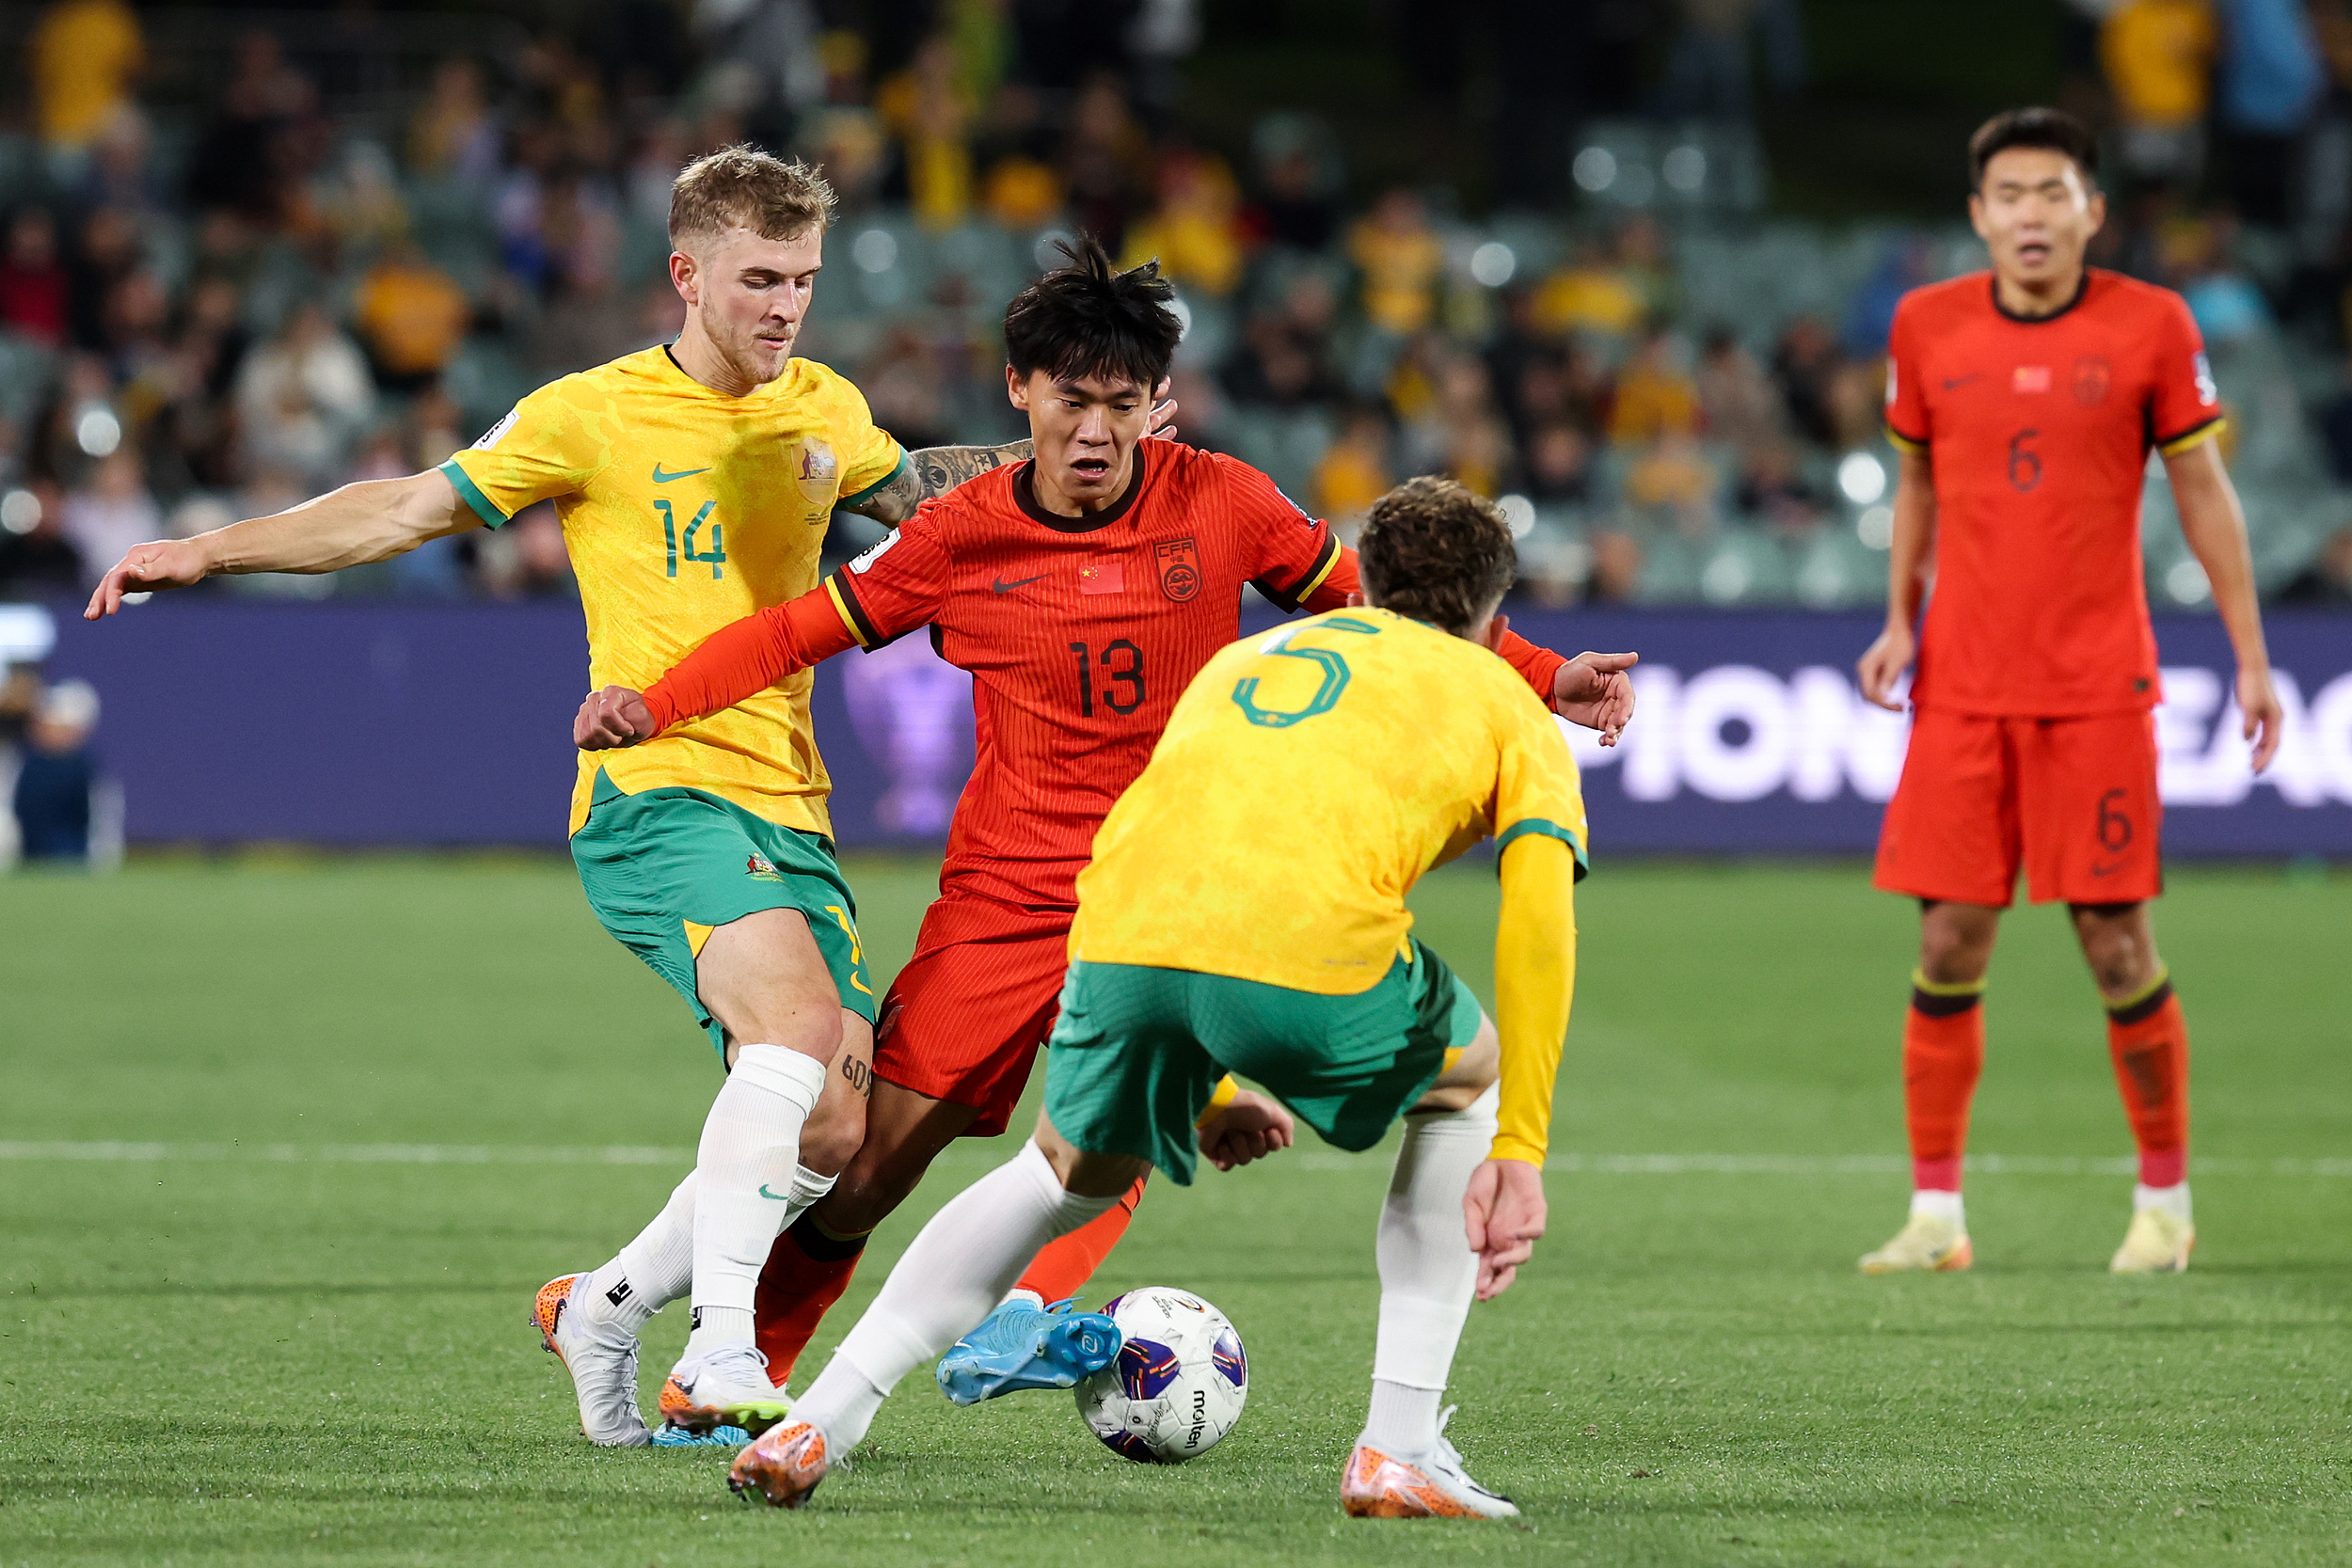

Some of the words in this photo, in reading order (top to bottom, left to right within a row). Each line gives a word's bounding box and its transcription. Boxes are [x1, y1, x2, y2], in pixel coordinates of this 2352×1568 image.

[2008, 428, 2042, 493] 6
[654, 499, 726, 579] 14
[1158, 542, 1194, 558] CFA
[1070, 639, 1146, 718] 13
[1232, 617, 1382, 728] 5
[2097, 787, 2133, 853] 6
[1184, 1390, 1206, 1449] molten
